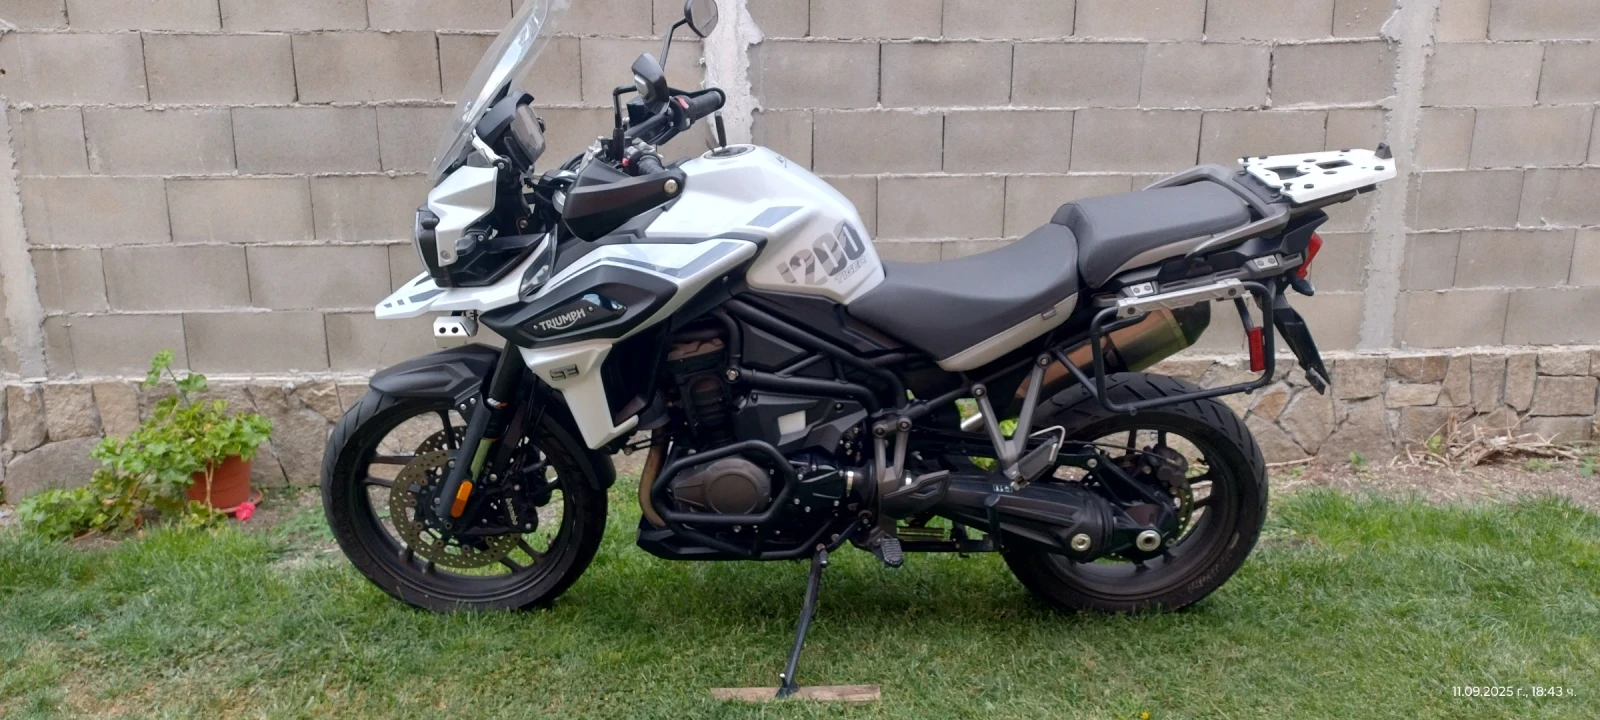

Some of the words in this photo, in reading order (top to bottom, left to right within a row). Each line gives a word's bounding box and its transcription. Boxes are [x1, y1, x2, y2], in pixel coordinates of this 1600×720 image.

[776, 218, 866, 286] 1200
[834, 255, 867, 285] TIGER
[539, 308, 586, 331] TRIUMPH
